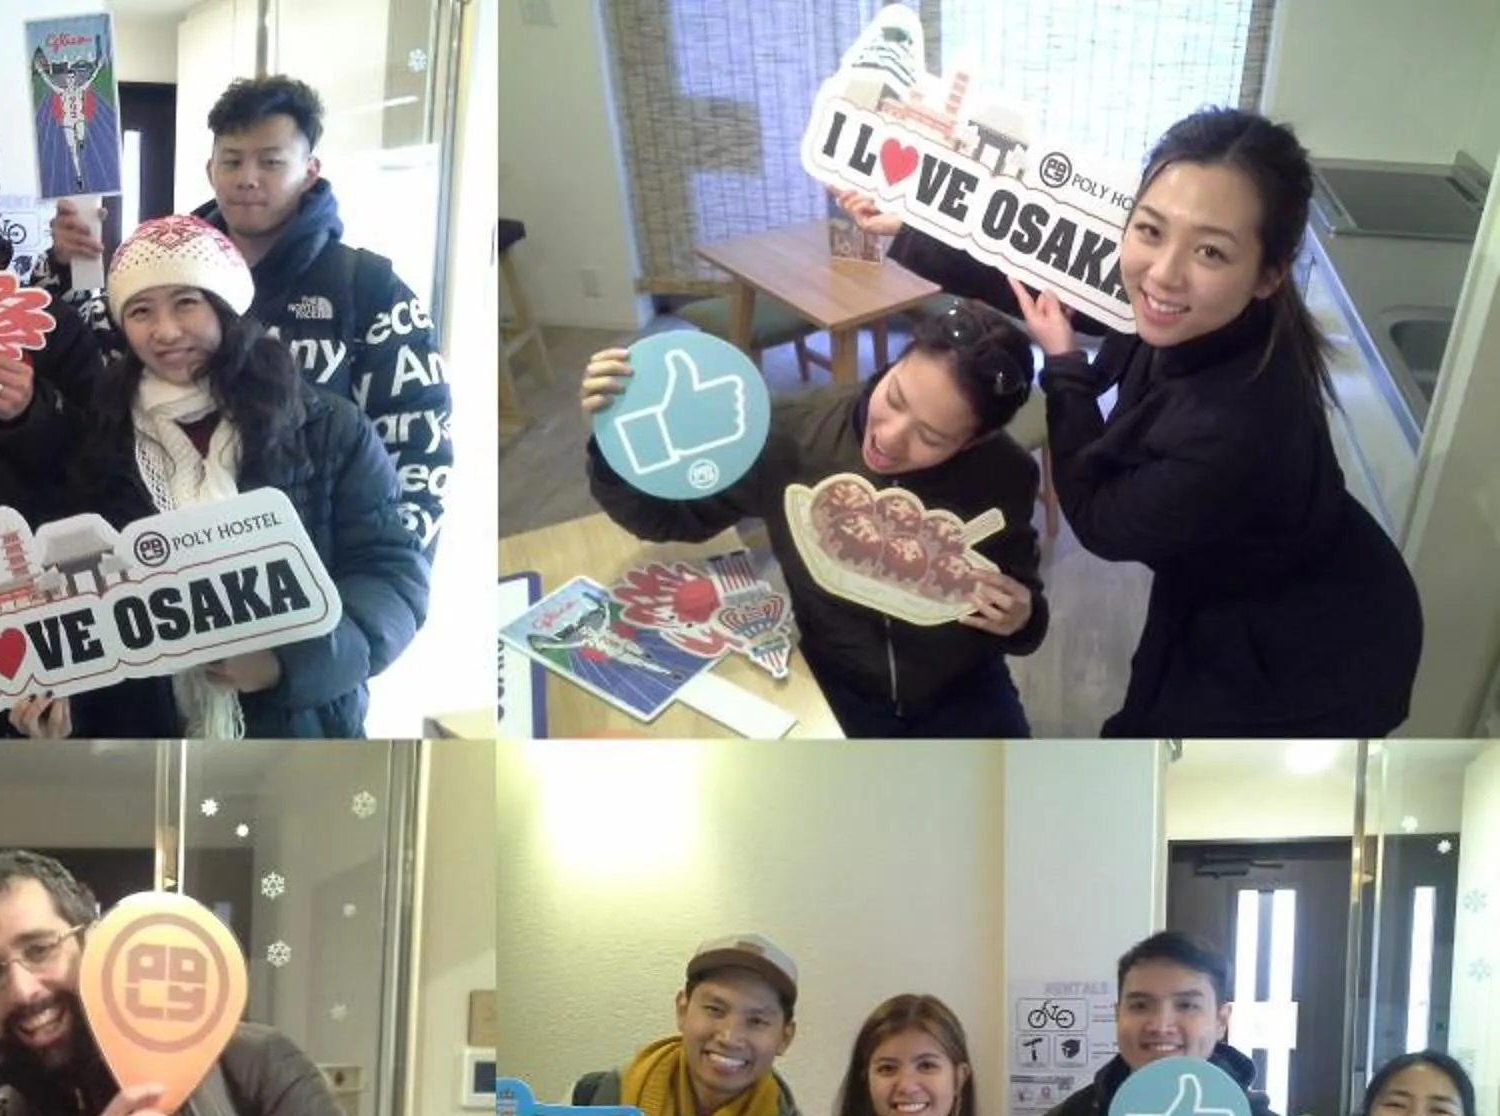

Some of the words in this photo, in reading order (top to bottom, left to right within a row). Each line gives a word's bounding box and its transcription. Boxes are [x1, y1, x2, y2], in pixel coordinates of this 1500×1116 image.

[822, 112, 847, 158] I
[1072, 174, 1109, 199] POLY
[172, 530, 214, 551] POLY
[219, 511, 281, 539] HOSTEL
[113, 559, 311, 650] OSAKA
